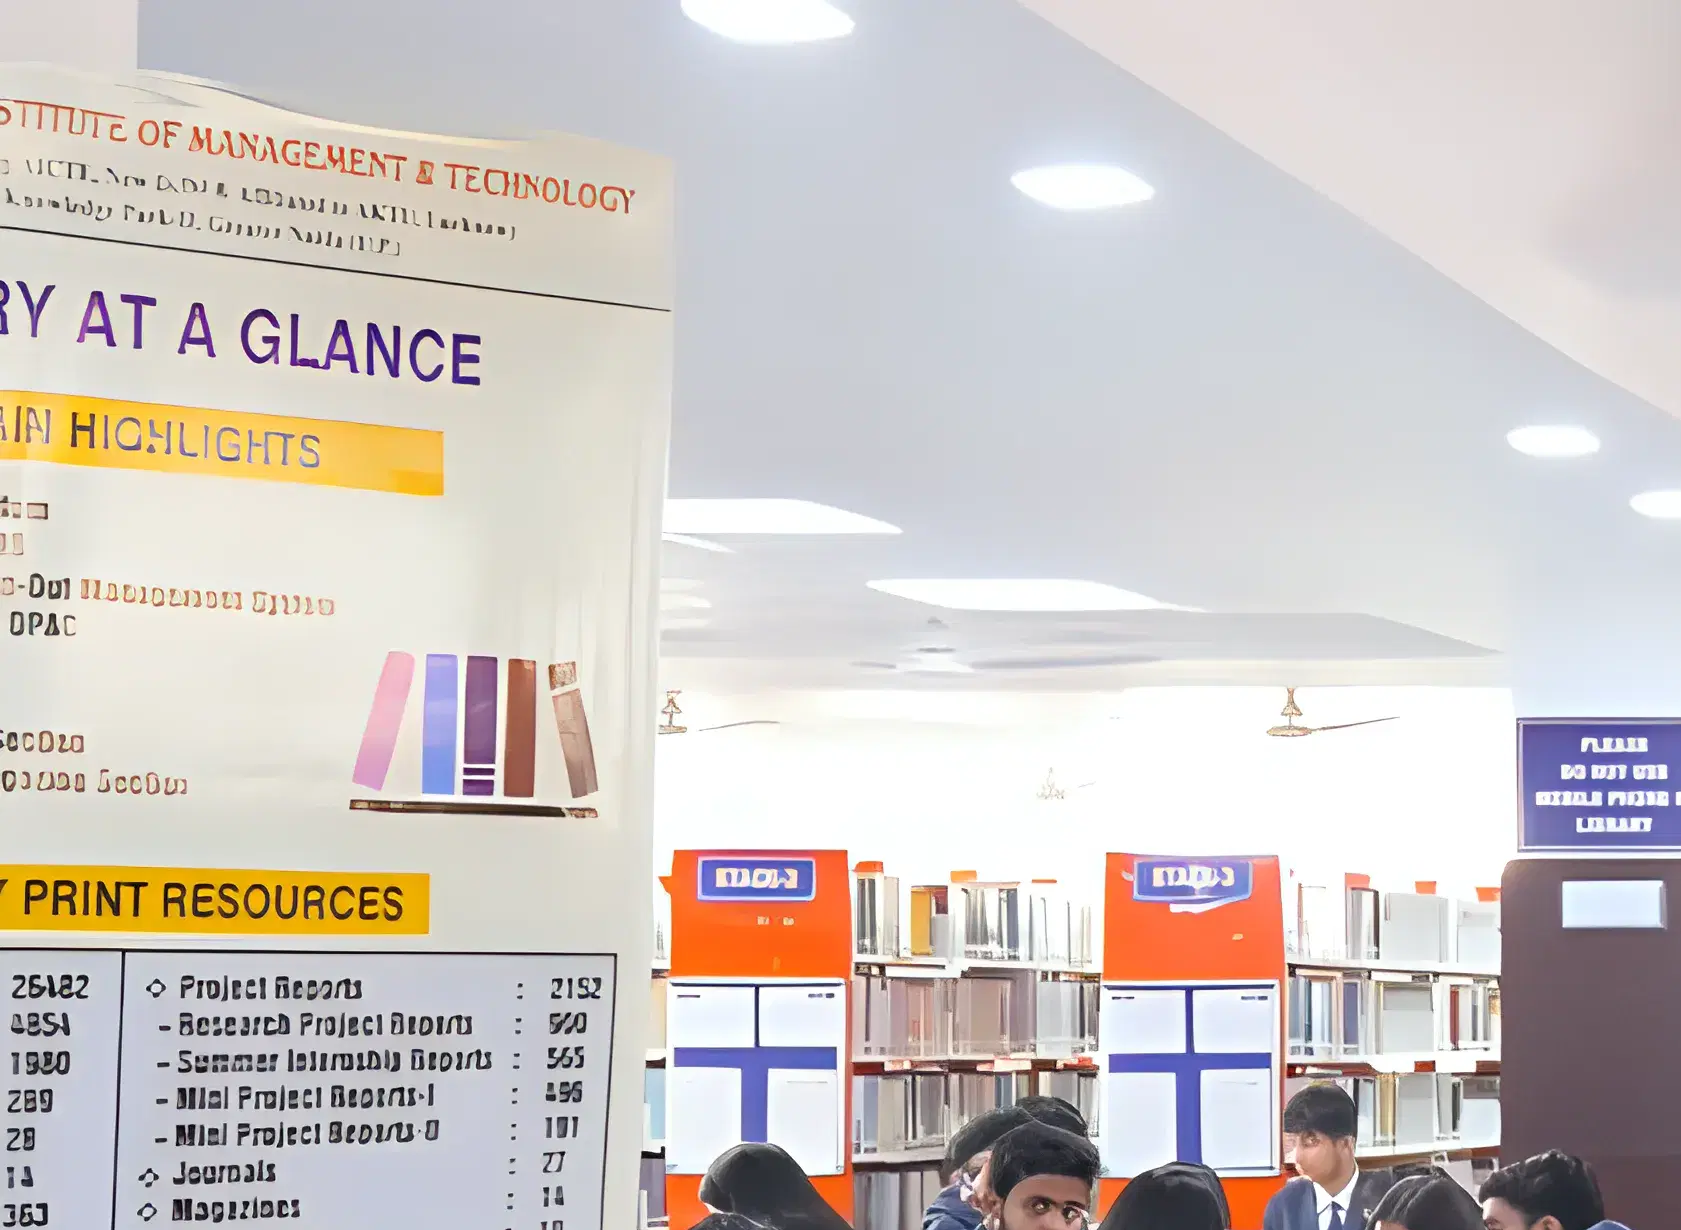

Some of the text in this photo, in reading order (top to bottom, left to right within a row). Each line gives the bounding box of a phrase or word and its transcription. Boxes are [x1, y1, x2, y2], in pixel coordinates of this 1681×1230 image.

[138, 119, 183, 149] OF
[188, 125, 407, 183] MANAGEMENT
[444, 162, 635, 214] TECHNOLOGY
[77, 291, 157, 349] AT
[178, 302, 216, 358] A
[241, 308, 481, 387] GLANCE
[70, 411, 321, 469] HIGHLIGHTS
[23, 879, 148, 918] PRINT
[163, 882, 404, 922] RESOURCES
[180, 975, 266, 1001] Project
[300, 1012, 383, 1039] Project
[177, 1050, 279, 1074] Summer
[238, 1085, 322, 1112] Project
[237, 1121, 321, 1149] Project
[172, 1160, 277, 1185] Journals
